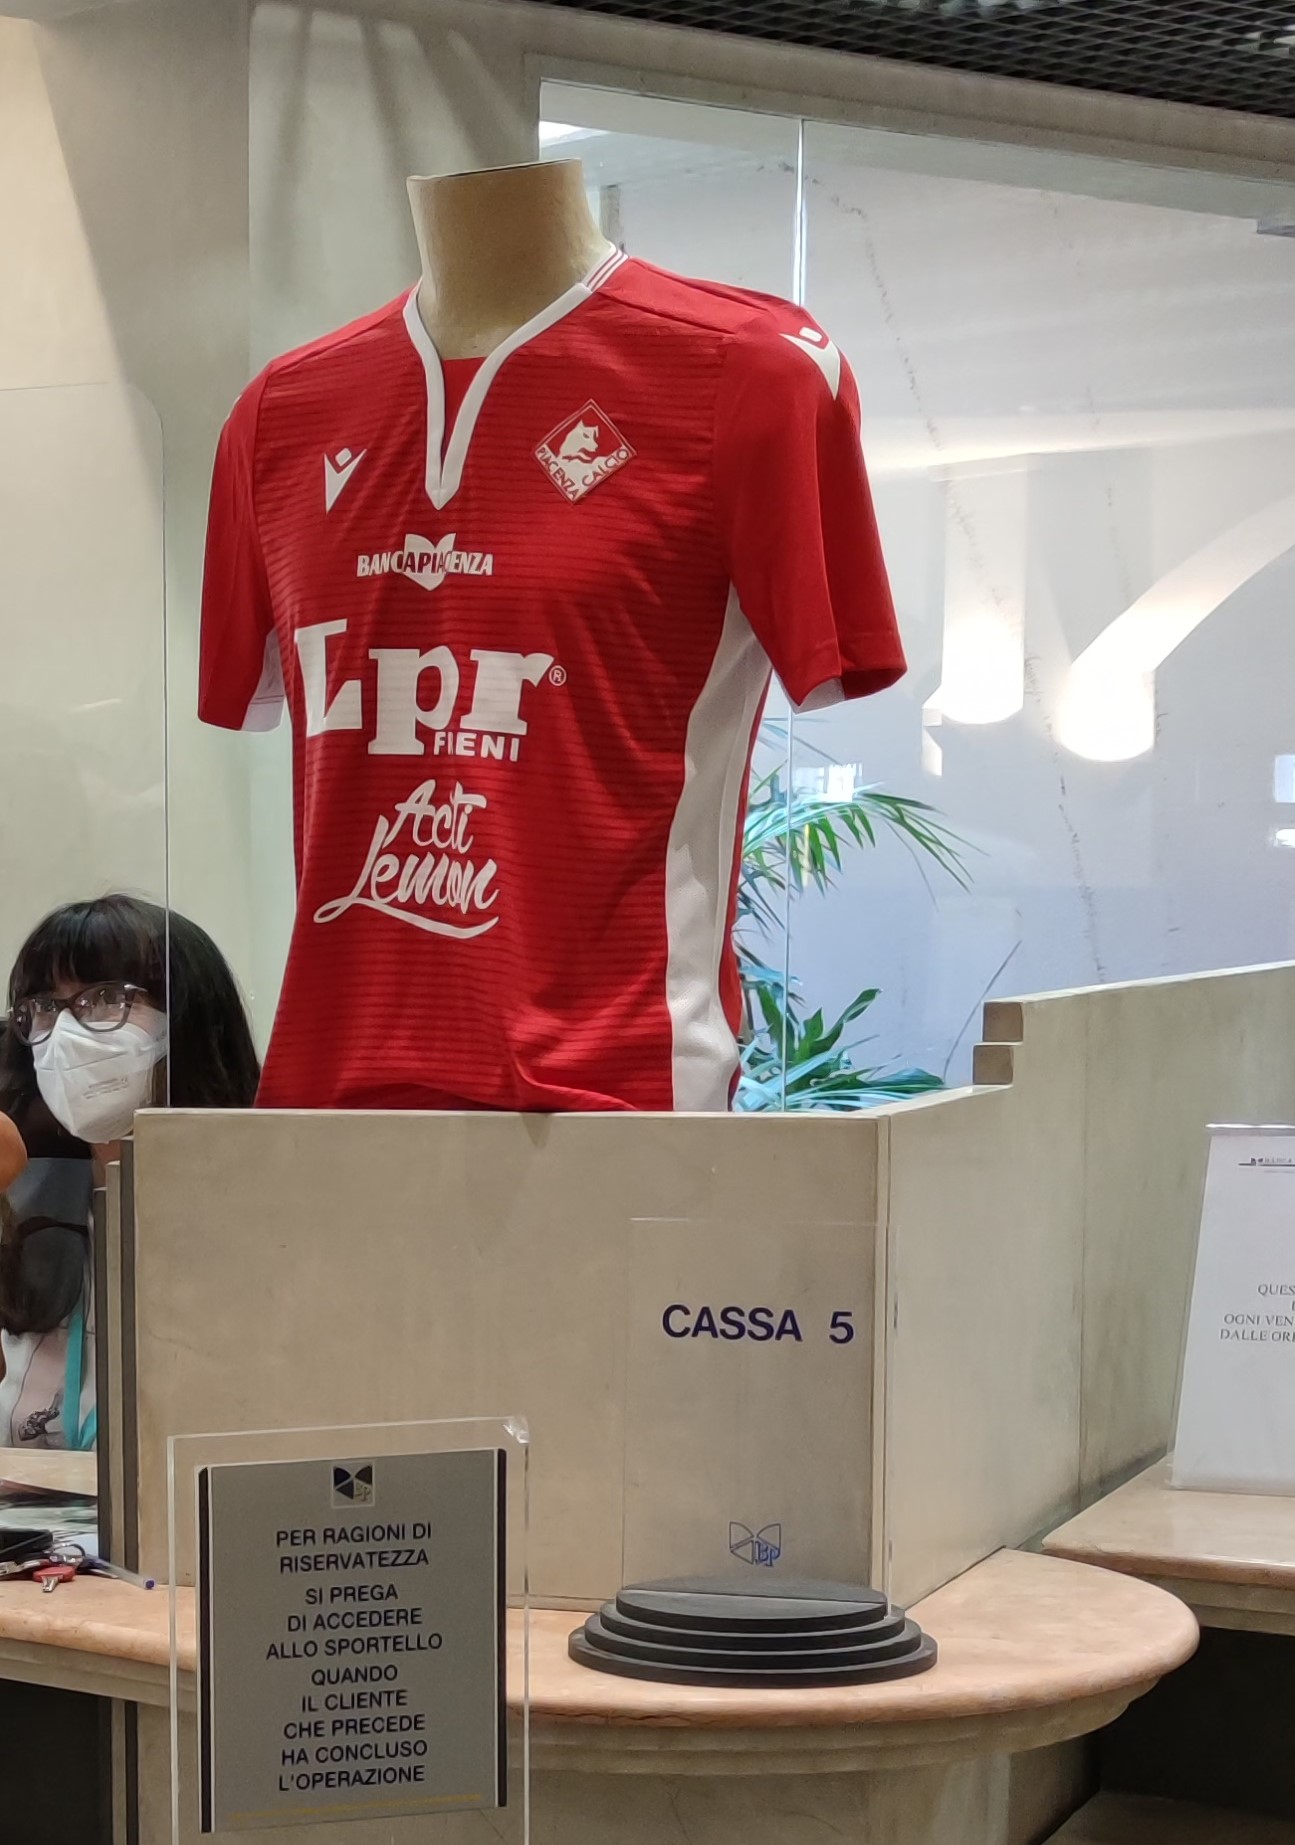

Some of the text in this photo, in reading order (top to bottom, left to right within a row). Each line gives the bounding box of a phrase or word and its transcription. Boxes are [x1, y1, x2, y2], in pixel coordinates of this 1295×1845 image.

[538, 447, 580, 500] PIACENZA
[582, 448, 629, 487] CALCIO
[434, 731, 520, 763] FIENI
[383, 779, 487, 854] Acti
[313, 814, 501, 940] Lemon
[662, 1304, 855, 1344] CASSA 5
[1224, 1313, 1260, 1326] OGNI
[1220, 1328, 1268, 1342] DALLE
[276, 1522, 432, 1548] PER RAGIONI DI
[280, 1548, 429, 1574] RISERVATEZZA
[305, 1584, 399, 1606] SI PREGA
[287, 1608, 423, 1632] DI ACCEDERE
[266, 1633, 443, 1661] ALLO SPORTELLO
[311, 1664, 398, 1687] QUANDO
[302, 1689, 408, 1713] IL CLIENTE
[283, 1714, 425, 1740] CHE PRECEDE
[281, 1740, 428, 1767] HA CONCLUSO
[278, 1765, 425, 1793] L'OPERAZIONE
